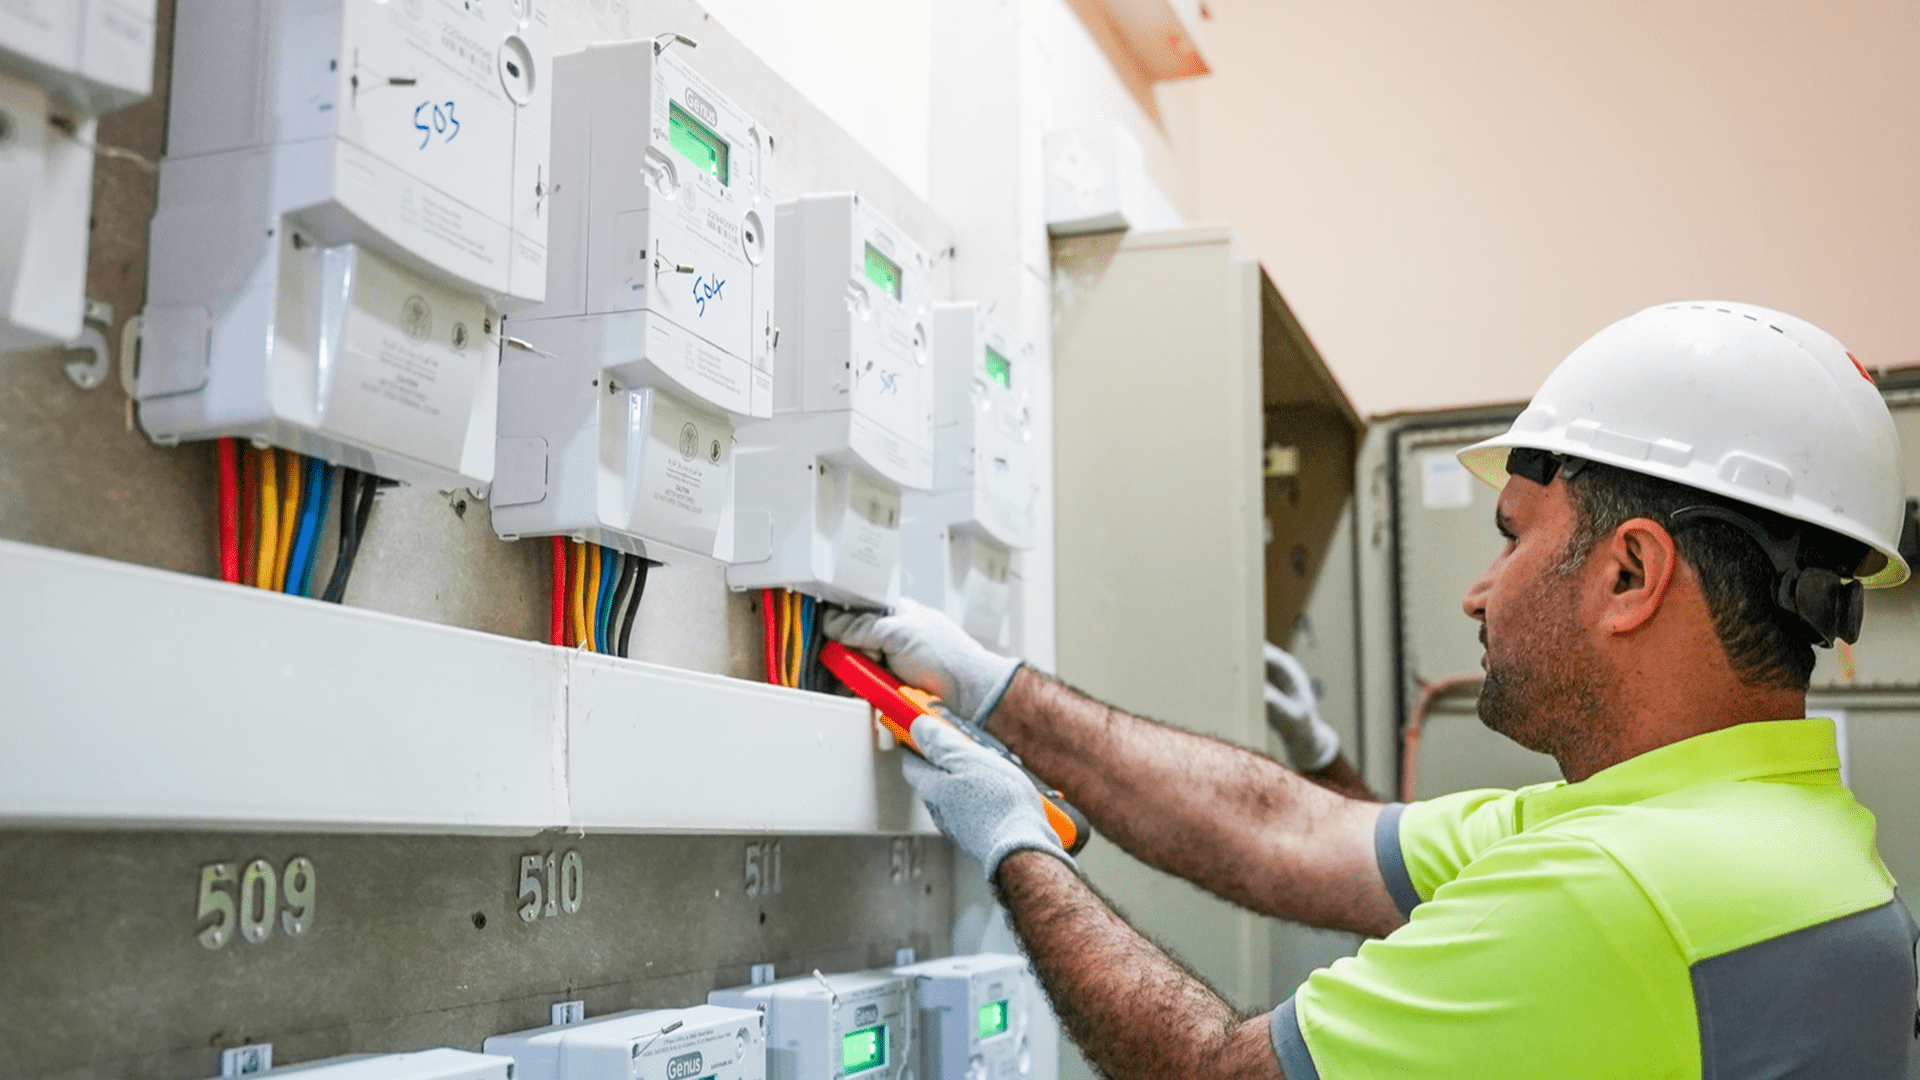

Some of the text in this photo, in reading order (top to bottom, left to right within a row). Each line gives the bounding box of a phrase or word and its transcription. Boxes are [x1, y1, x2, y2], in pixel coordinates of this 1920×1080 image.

[414, 100, 460, 150] 503
[693, 273, 725, 317] 504
[518, 850, 584, 922] 510
[745, 842, 781, 899] 511
[197, 856, 316, 950] 509
